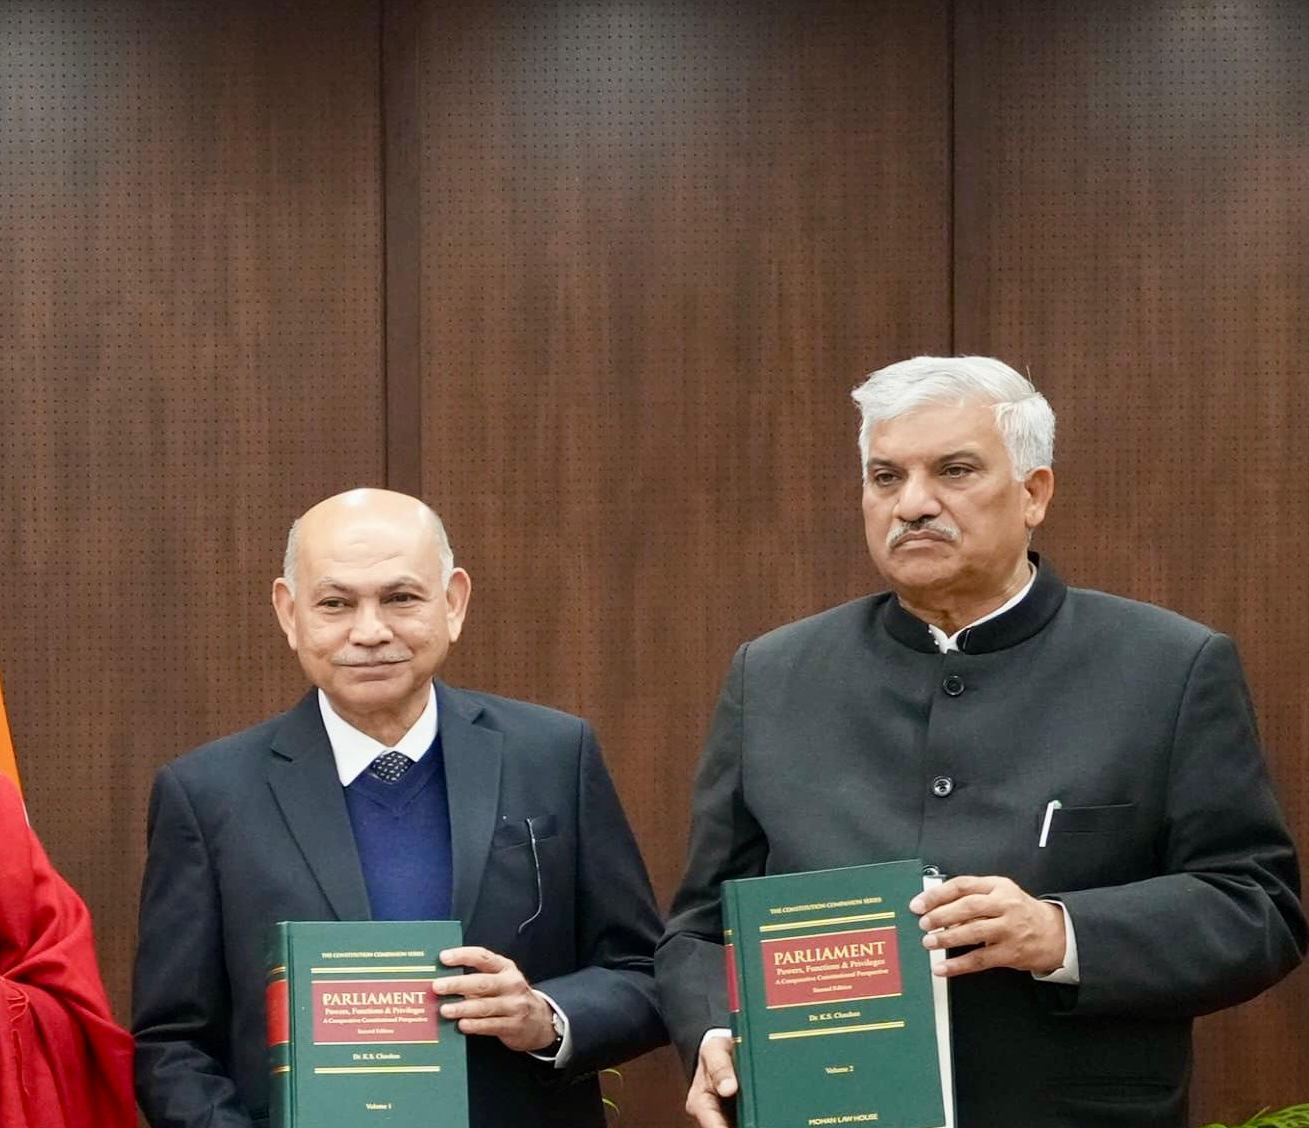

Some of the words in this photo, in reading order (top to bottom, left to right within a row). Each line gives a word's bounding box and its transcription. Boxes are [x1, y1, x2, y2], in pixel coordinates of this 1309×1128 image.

[774, 941, 887, 966] PARLIAMENT
[777, 966, 804, 976] Powers,
[806, 963, 840, 973] Functions
[851, 958, 885, 970] Privileges
[323, 992, 427, 1006] PARLIAMENT
[394, 1007, 425, 1016] Privileges
[826, 1066, 849, 1074] Volume
[809, 1116, 836, 1125] MOHAN
[838, 1115, 852, 1123] LAW
[854, 1113, 878, 1121] HOUSE
